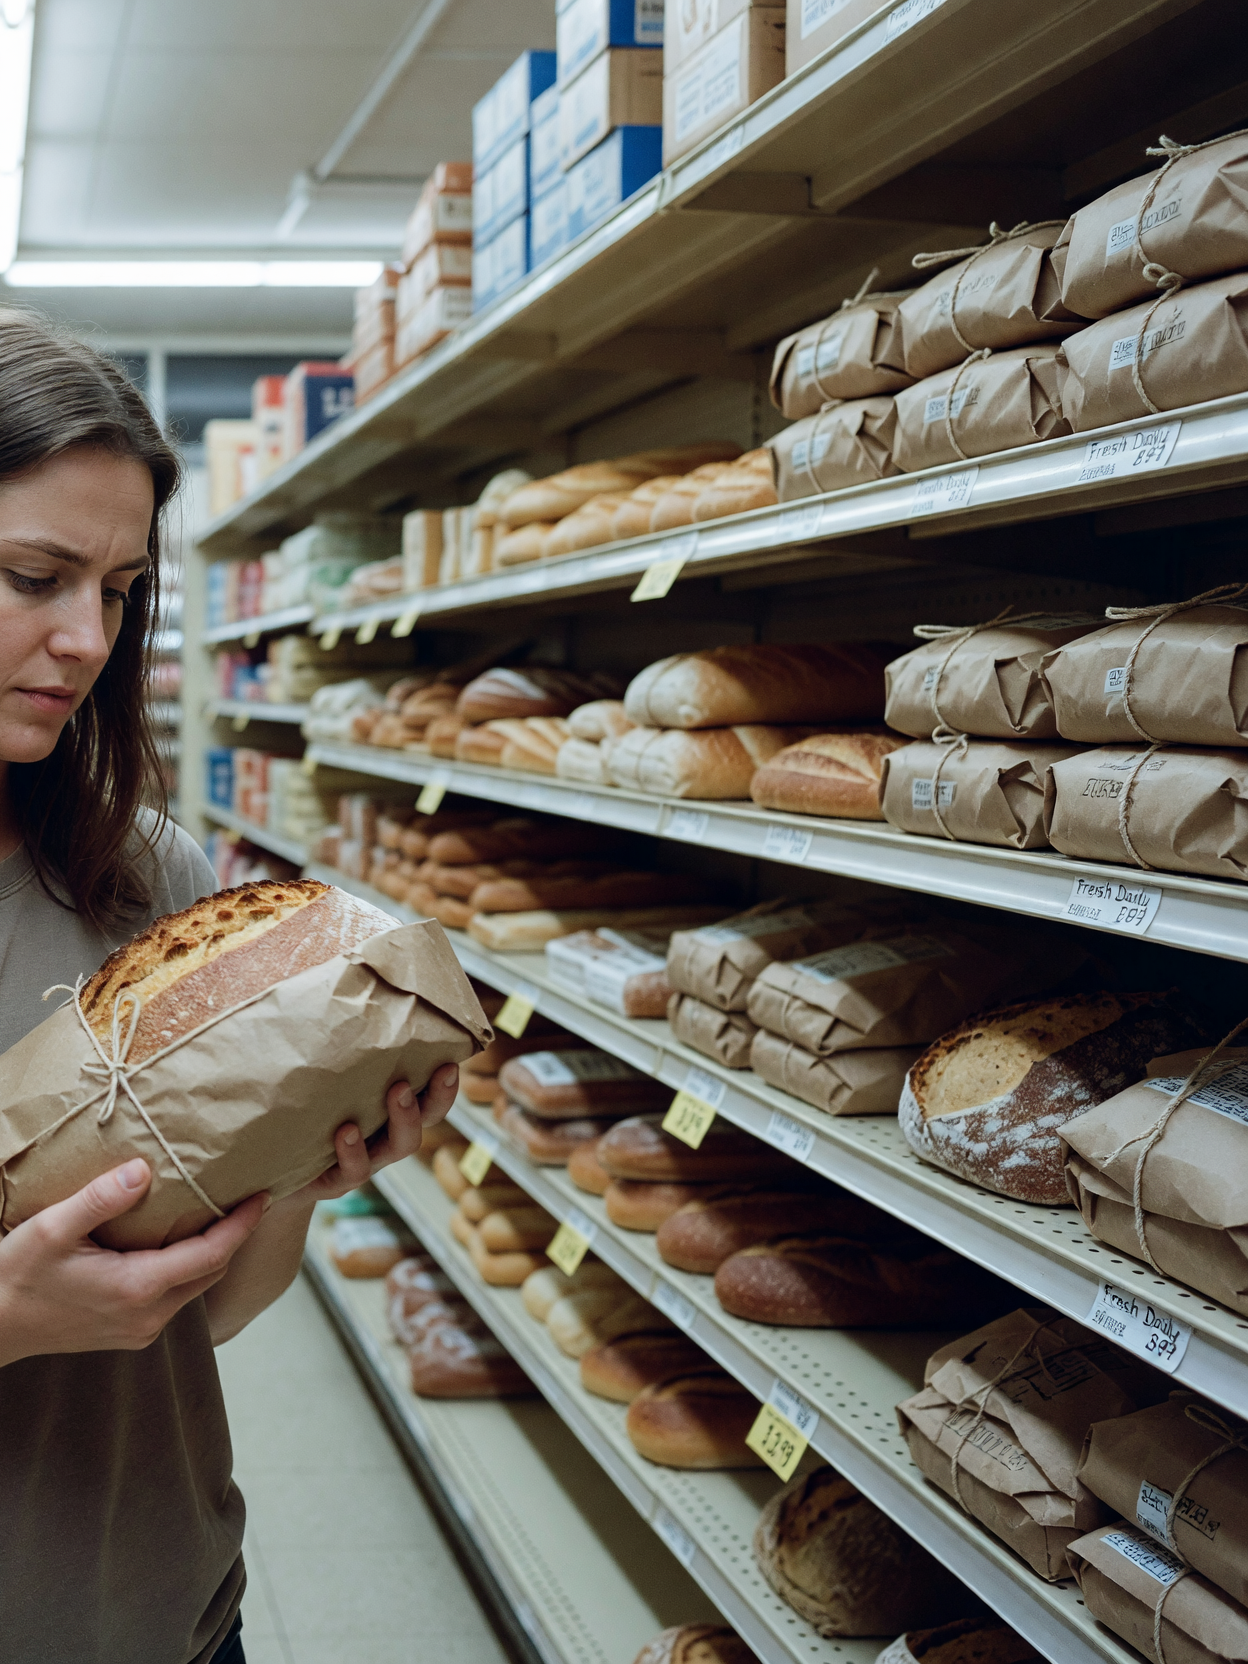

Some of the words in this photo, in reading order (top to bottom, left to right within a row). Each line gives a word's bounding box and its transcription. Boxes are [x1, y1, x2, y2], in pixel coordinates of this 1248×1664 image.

[1088, 437, 1127, 462] Fresh
[1115, 884, 1151, 907] Daily
[1104, 1284, 1140, 1318] Fresh
[1143, 1305, 1181, 1345] Daily
